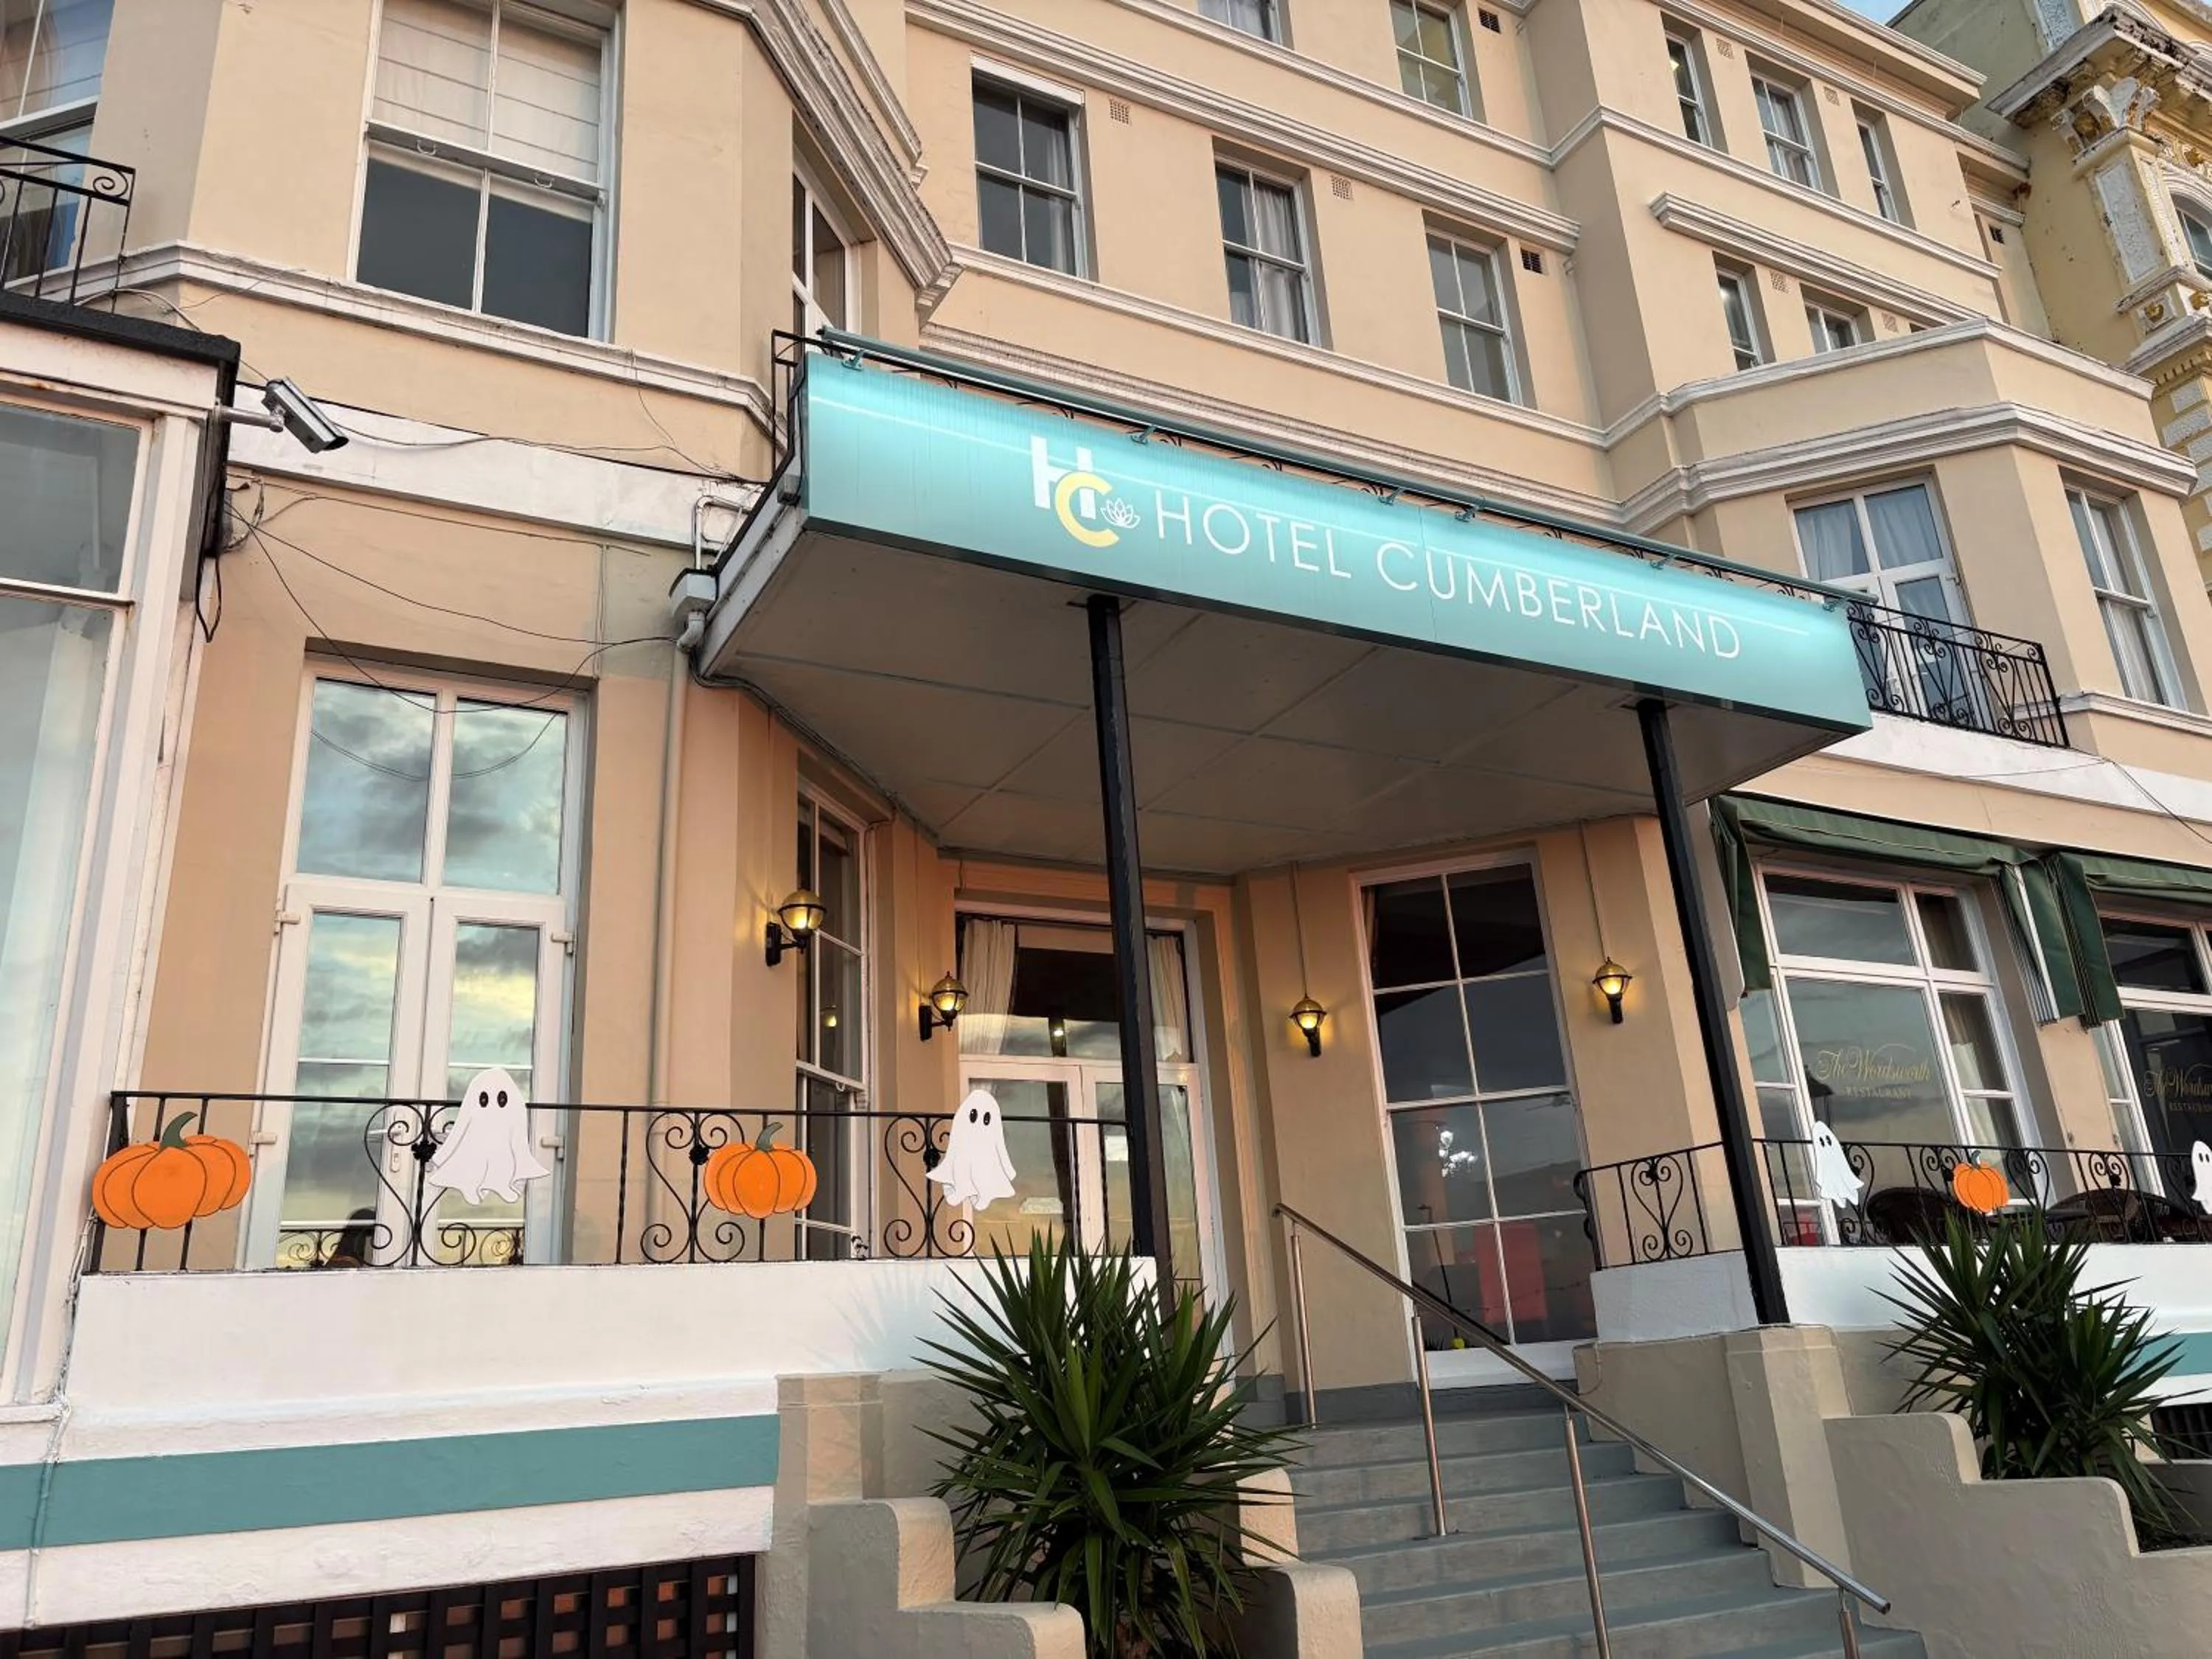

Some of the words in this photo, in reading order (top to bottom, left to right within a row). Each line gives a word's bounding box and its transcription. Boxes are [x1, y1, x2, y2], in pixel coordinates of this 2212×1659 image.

[1155, 490, 1352, 578] HOTEL
[1377, 542, 1741, 659] CUMBERLAND
[1815, 1049, 1847, 1081] The
[1844, 1085, 1912, 1099] RESTAURANT
